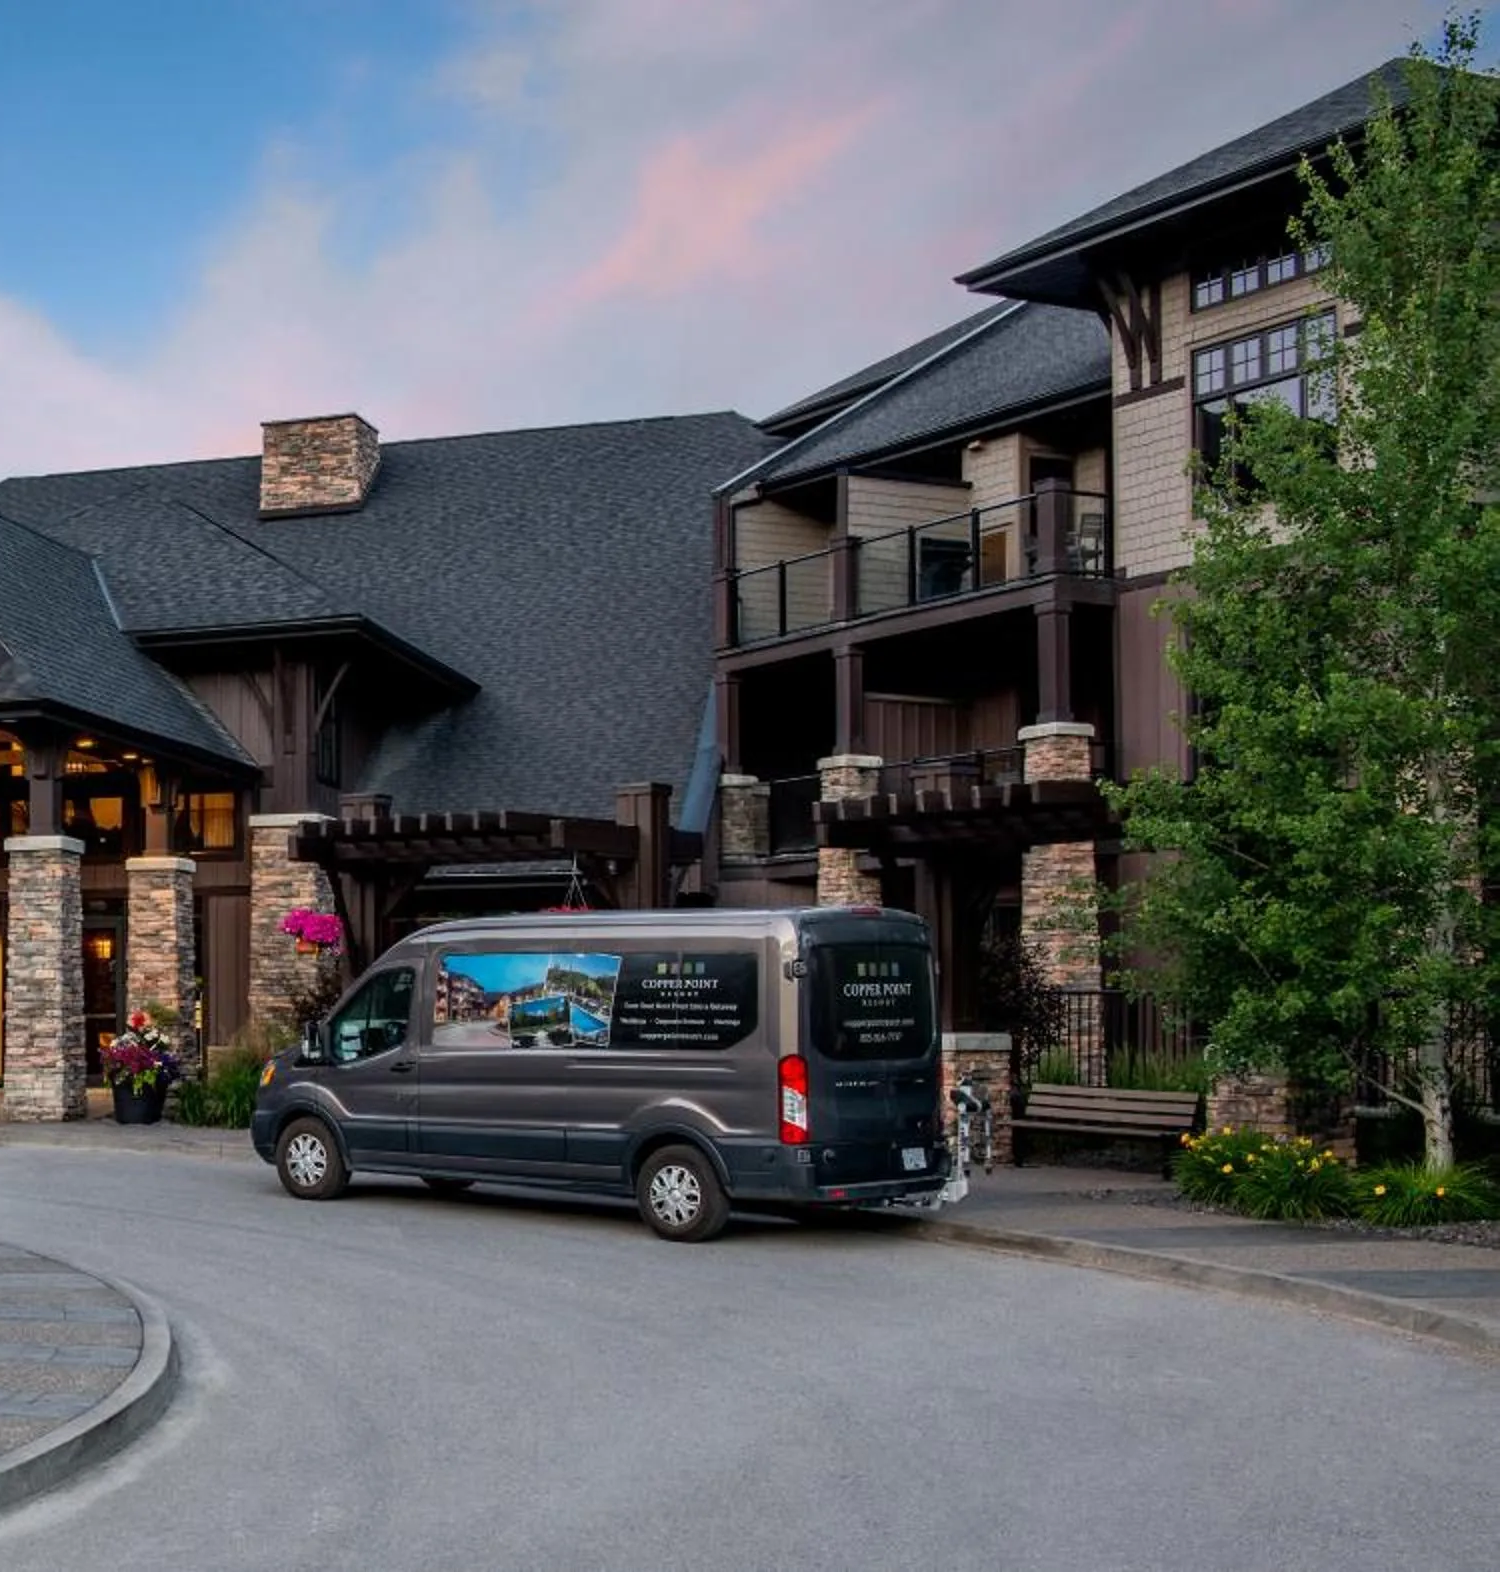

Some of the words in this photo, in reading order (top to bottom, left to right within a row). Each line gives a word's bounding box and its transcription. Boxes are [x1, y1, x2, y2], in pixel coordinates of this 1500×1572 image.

[641, 979, 682, 989] COPPER
[684, 979, 719, 989] POINT
[843, 983, 881, 997] COPPER
[883, 983, 912, 997] POINT
